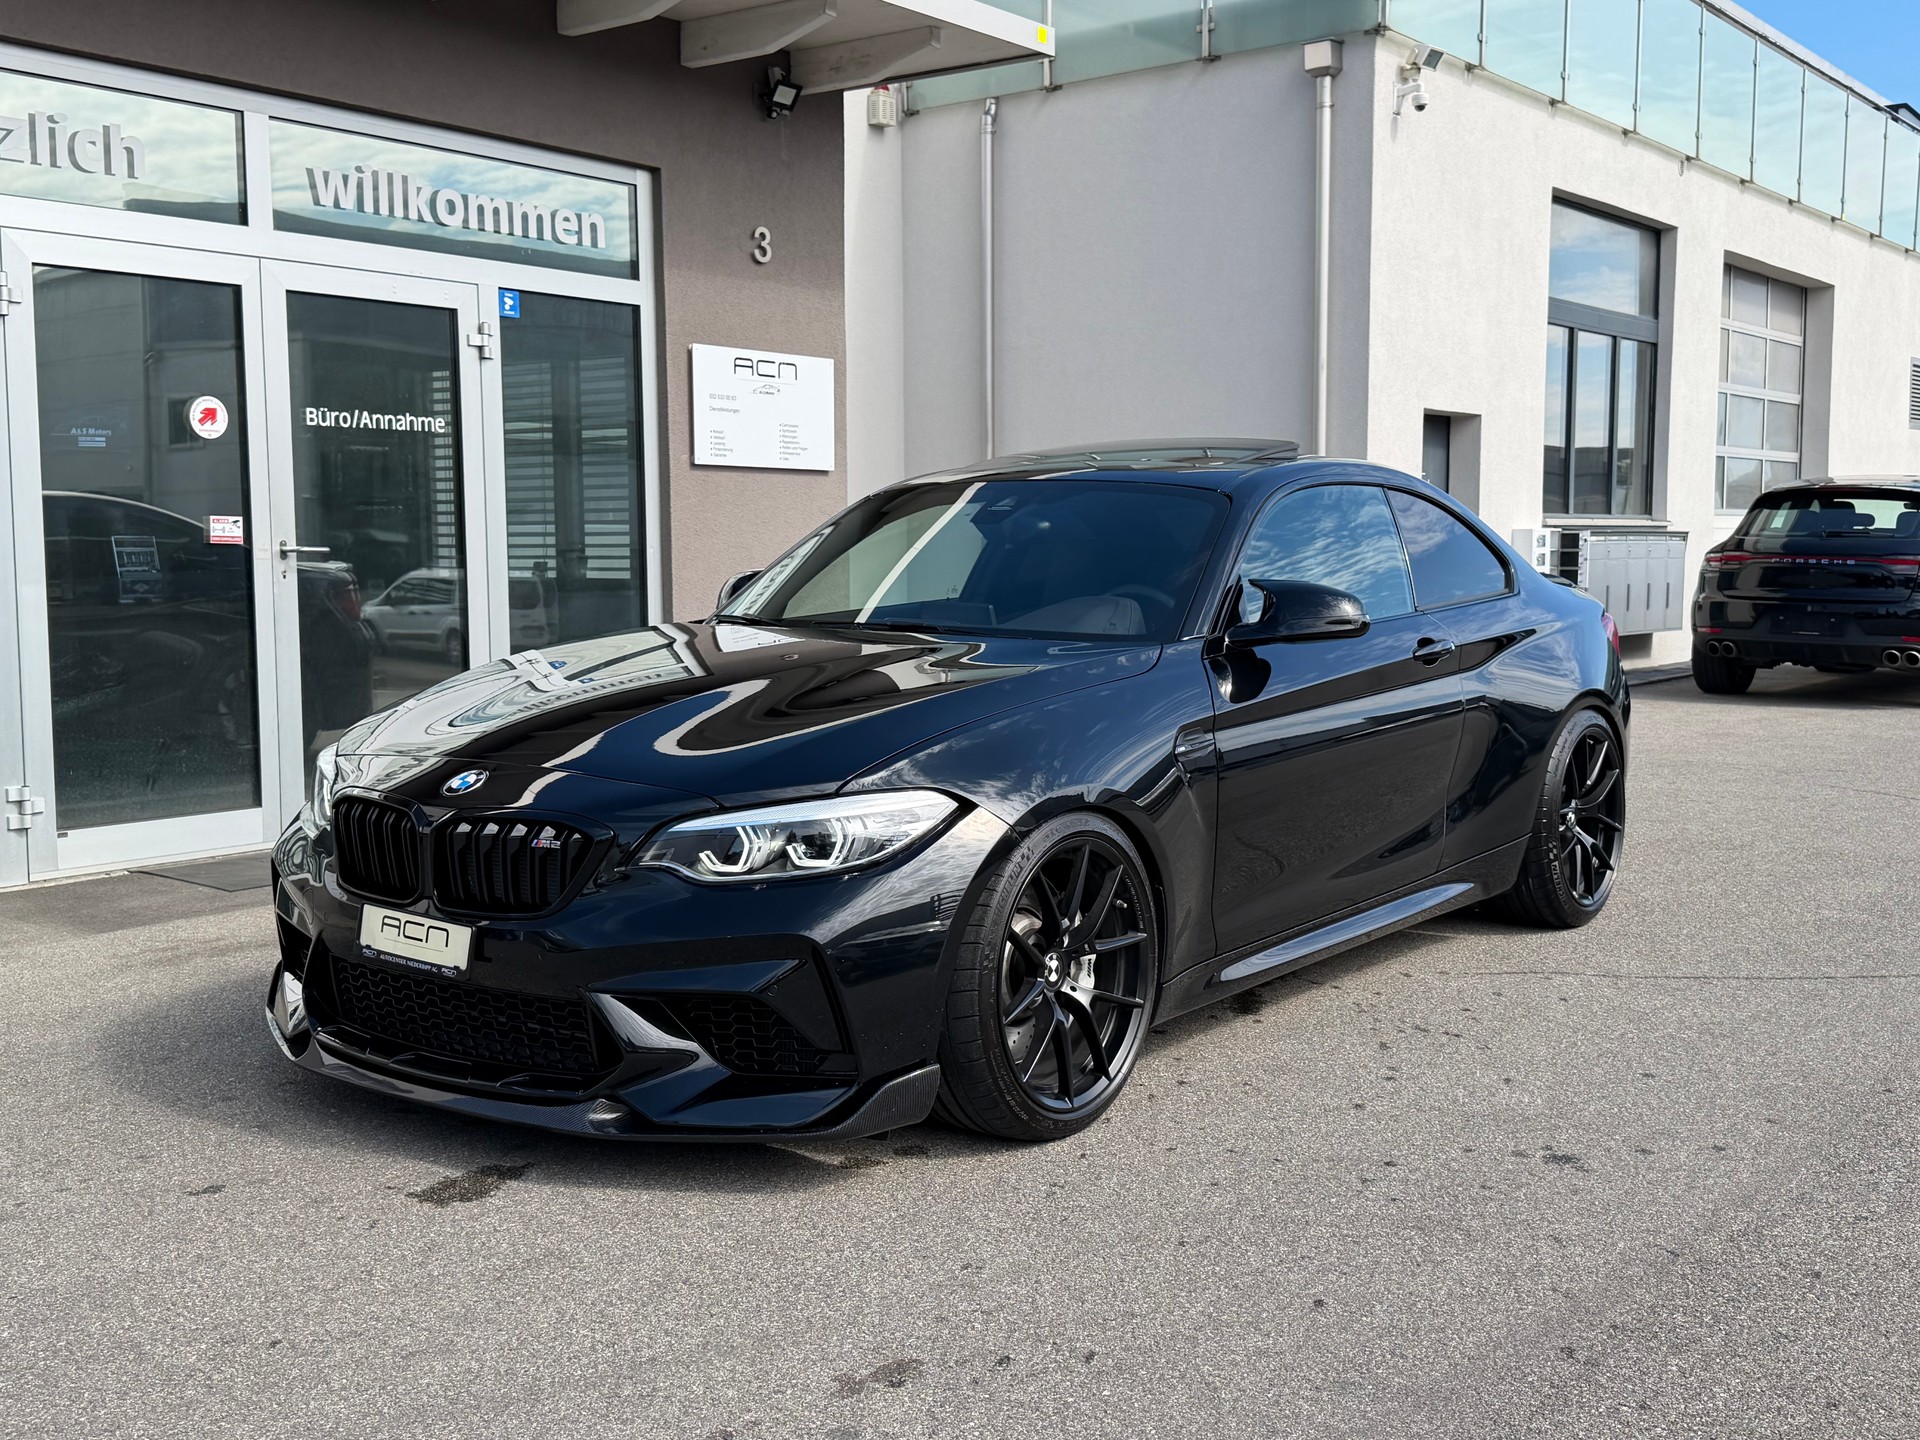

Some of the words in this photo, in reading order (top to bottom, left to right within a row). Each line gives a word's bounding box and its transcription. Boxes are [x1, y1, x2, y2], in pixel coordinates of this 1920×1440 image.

[307, 165, 606, 249] willkommen
[753, 226, 772, 264] 3
[305, 407, 446, 433] Büro/Annahme
[379, 953, 407, 965] AUTOCENTER
